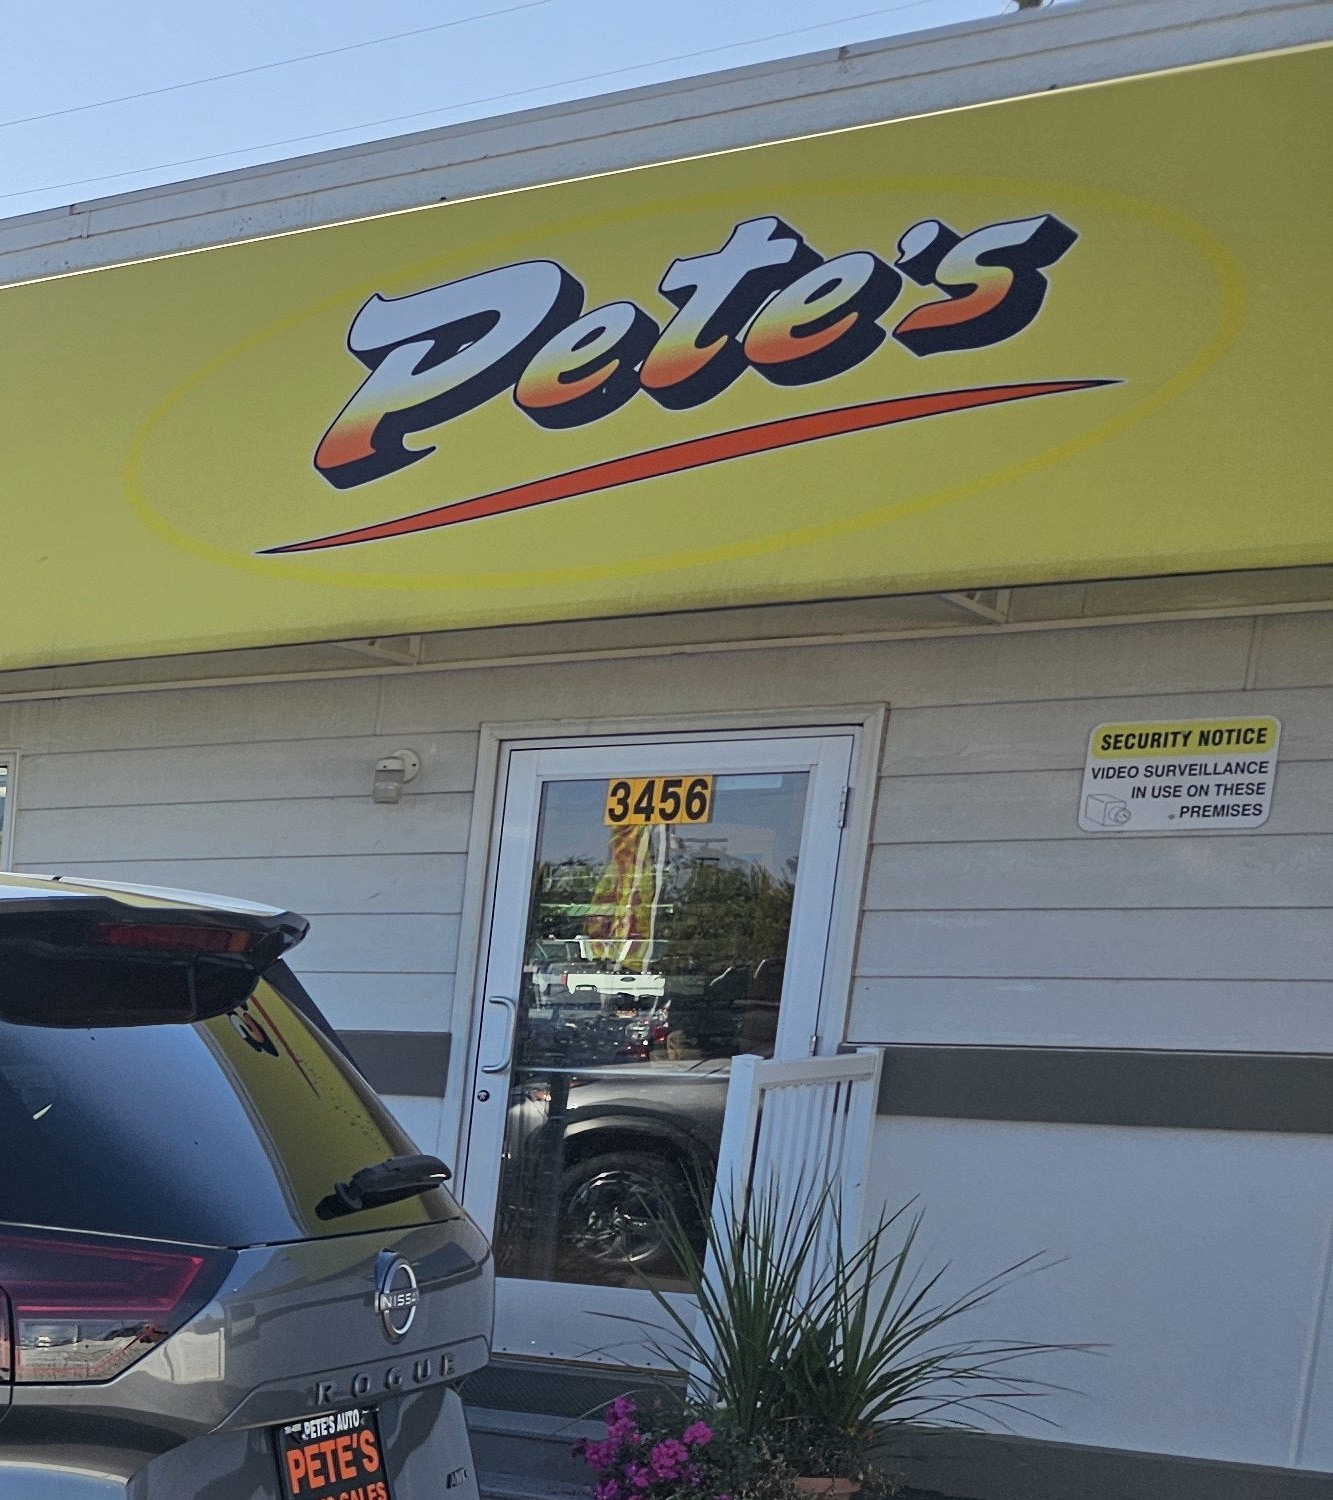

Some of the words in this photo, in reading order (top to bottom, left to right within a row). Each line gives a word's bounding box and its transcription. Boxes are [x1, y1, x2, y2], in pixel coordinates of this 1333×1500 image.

[313, 212, 1079, 490] Pete's
[1100, 731, 1193, 751] SECURITY
[1197, 727, 1268, 747] NOTICE
[1091, 765, 1140, 780] VIDEO
[1143, 761, 1270, 778] SURVEILLANCE
[608, 778, 709, 823] 3456
[1131, 786, 1147, 799] IN
[1151, 785, 1183, 799] USE
[1186, 784, 1209, 797] ON
[1214, 782, 1267, 796] THESE
[1179, 803, 1263, 819] PREMISES
[315, 1352, 456, 1406] ROGUE
[336, 1408, 360, 1433] AUTO
[286, 1429, 381, 1495] PETE'S
